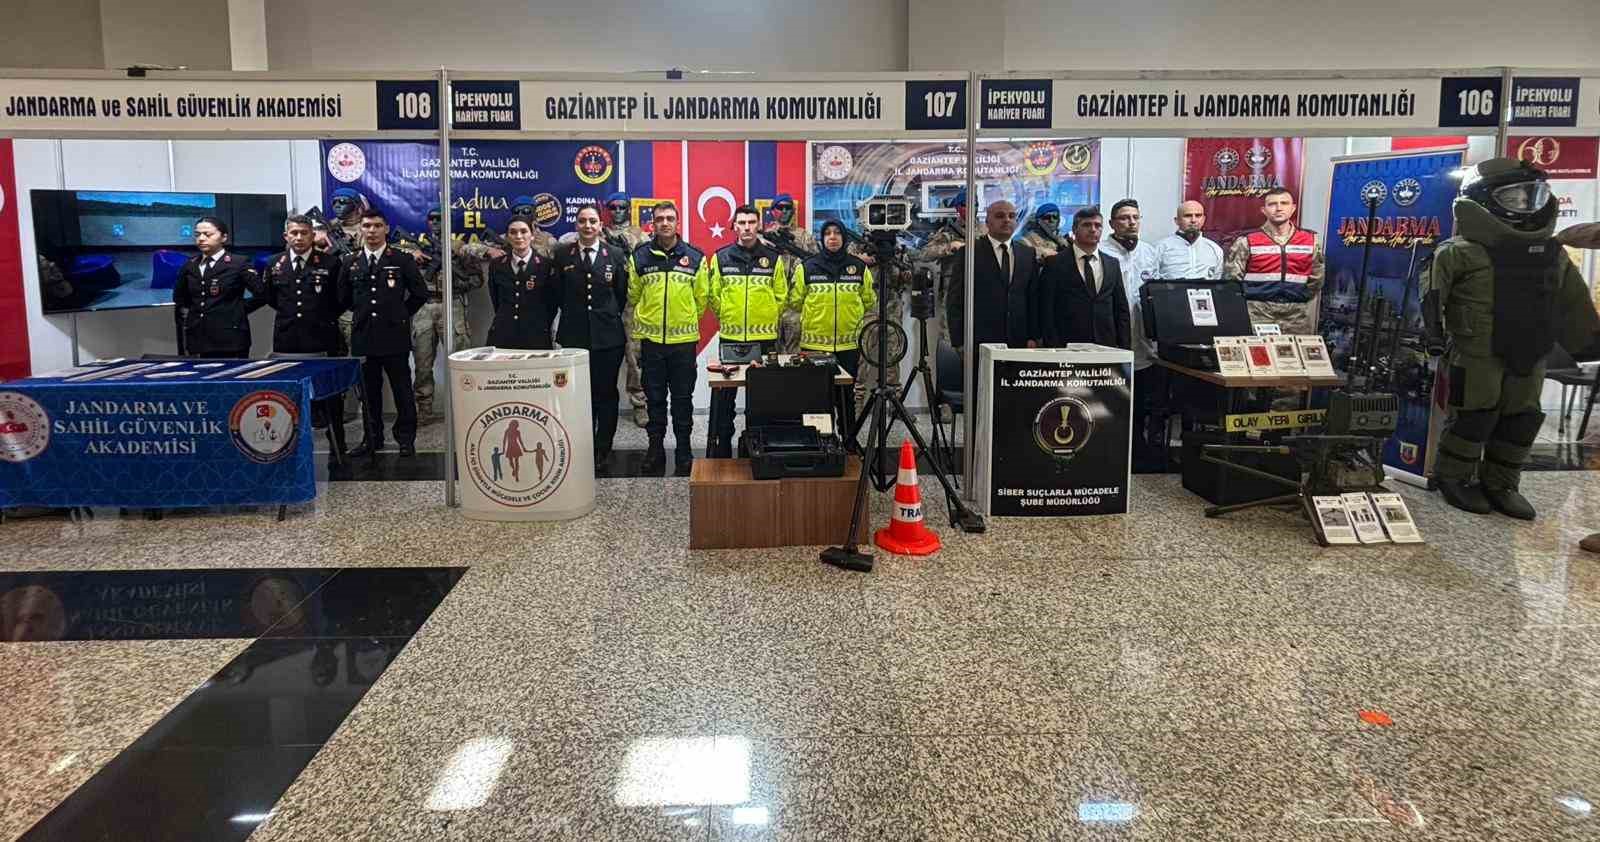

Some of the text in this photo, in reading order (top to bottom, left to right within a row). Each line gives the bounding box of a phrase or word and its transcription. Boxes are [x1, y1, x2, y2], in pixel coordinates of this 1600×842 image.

[455, 91, 513, 107] İPEKYOLU
[988, 88, 1045, 105] İPEKYOLU
[1516, 85, 1573, 103] İPEKYOLU
[6, 93, 342, 119] JANDARMA ve SAHİL GÜVENLİK AKADEMİSİ
[395, 92, 432, 120] 108
[545, 92, 882, 120] GAZİANTEP İL JANDARMA KOMUTANLIĞI
[924, 91, 956, 117] 107
[1077, 91, 1415, 118] GAZİANTEP İL JANDARMA KOMUTANLIĞI
[1458, 90, 1493, 116] 106
[455, 108, 514, 122] KARİYER FUARI
[987, 106, 1045, 120] KARİYER FUARI
[1514, 104, 1571, 118] KARİYER FUARI
[461, 147, 479, 157] T.C.
[480, 158, 520, 168] VALİLİĞİ
[910, 156, 960, 165] GAZİANTEP
[413, 170, 469, 179] JANDRMA
[471, 169, 539, 180] KOMUTANLIĞI
[906, 166, 955, 177] JANDARMA
[956, 165, 1019, 176] KOUTANLIĞI
[1199, 174, 1285, 191] JANDARMA
[566, 197, 596, 205] KADINA
[463, 211, 486, 229] EL
[1337, 215, 1441, 236] JANDARMA
[1019, 367, 1112, 378] GAZİANTEP VALİLİĞİ
[1001, 377, 1126, 388] İL JANDARMA KOMUTANLIĞI
[65, 401, 209, 416] JANDARMA VE
[479, 406, 549, 429] JANDARMA
[1233, 416, 1258, 428] OLAY
[54, 417, 223, 435] SAHİL GÜVENLİK
[84, 438, 197, 455] AKADEMİSİ
[997, 486, 1120, 498] SİBER SUÇLARLA MÜCADELE
[1020, 496, 1101, 508] ŞUBE MÜDÜRLÜĞÜ
